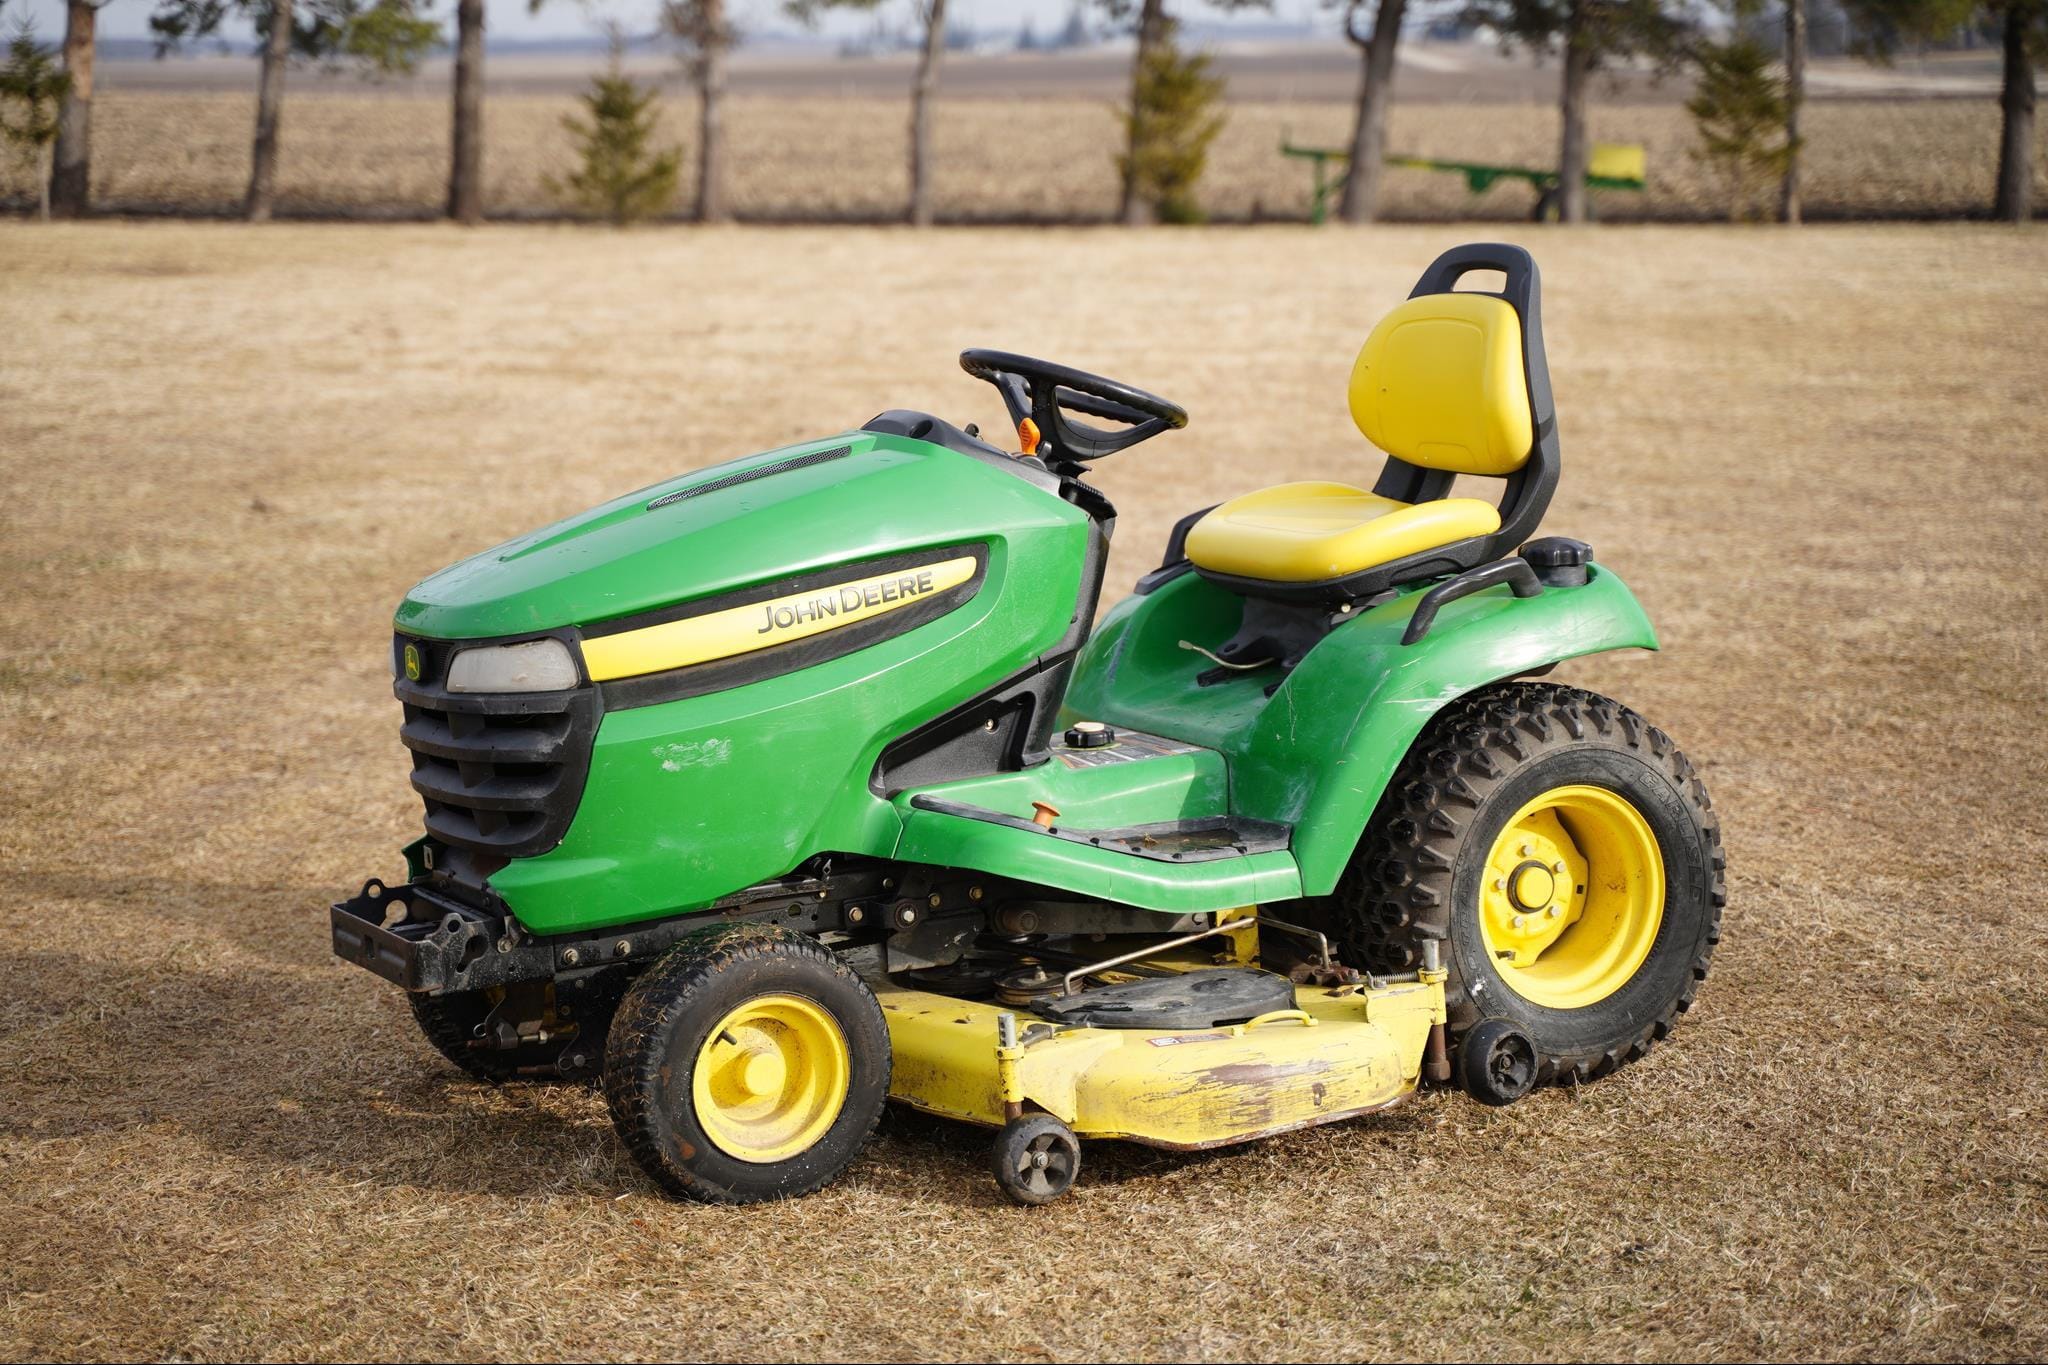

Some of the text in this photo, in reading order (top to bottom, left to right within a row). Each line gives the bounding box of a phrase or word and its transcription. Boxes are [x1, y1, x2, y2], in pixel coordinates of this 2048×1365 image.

[758, 571, 934, 634] JOHN DEERE
[1639, 771, 1703, 906] CARLISLE
